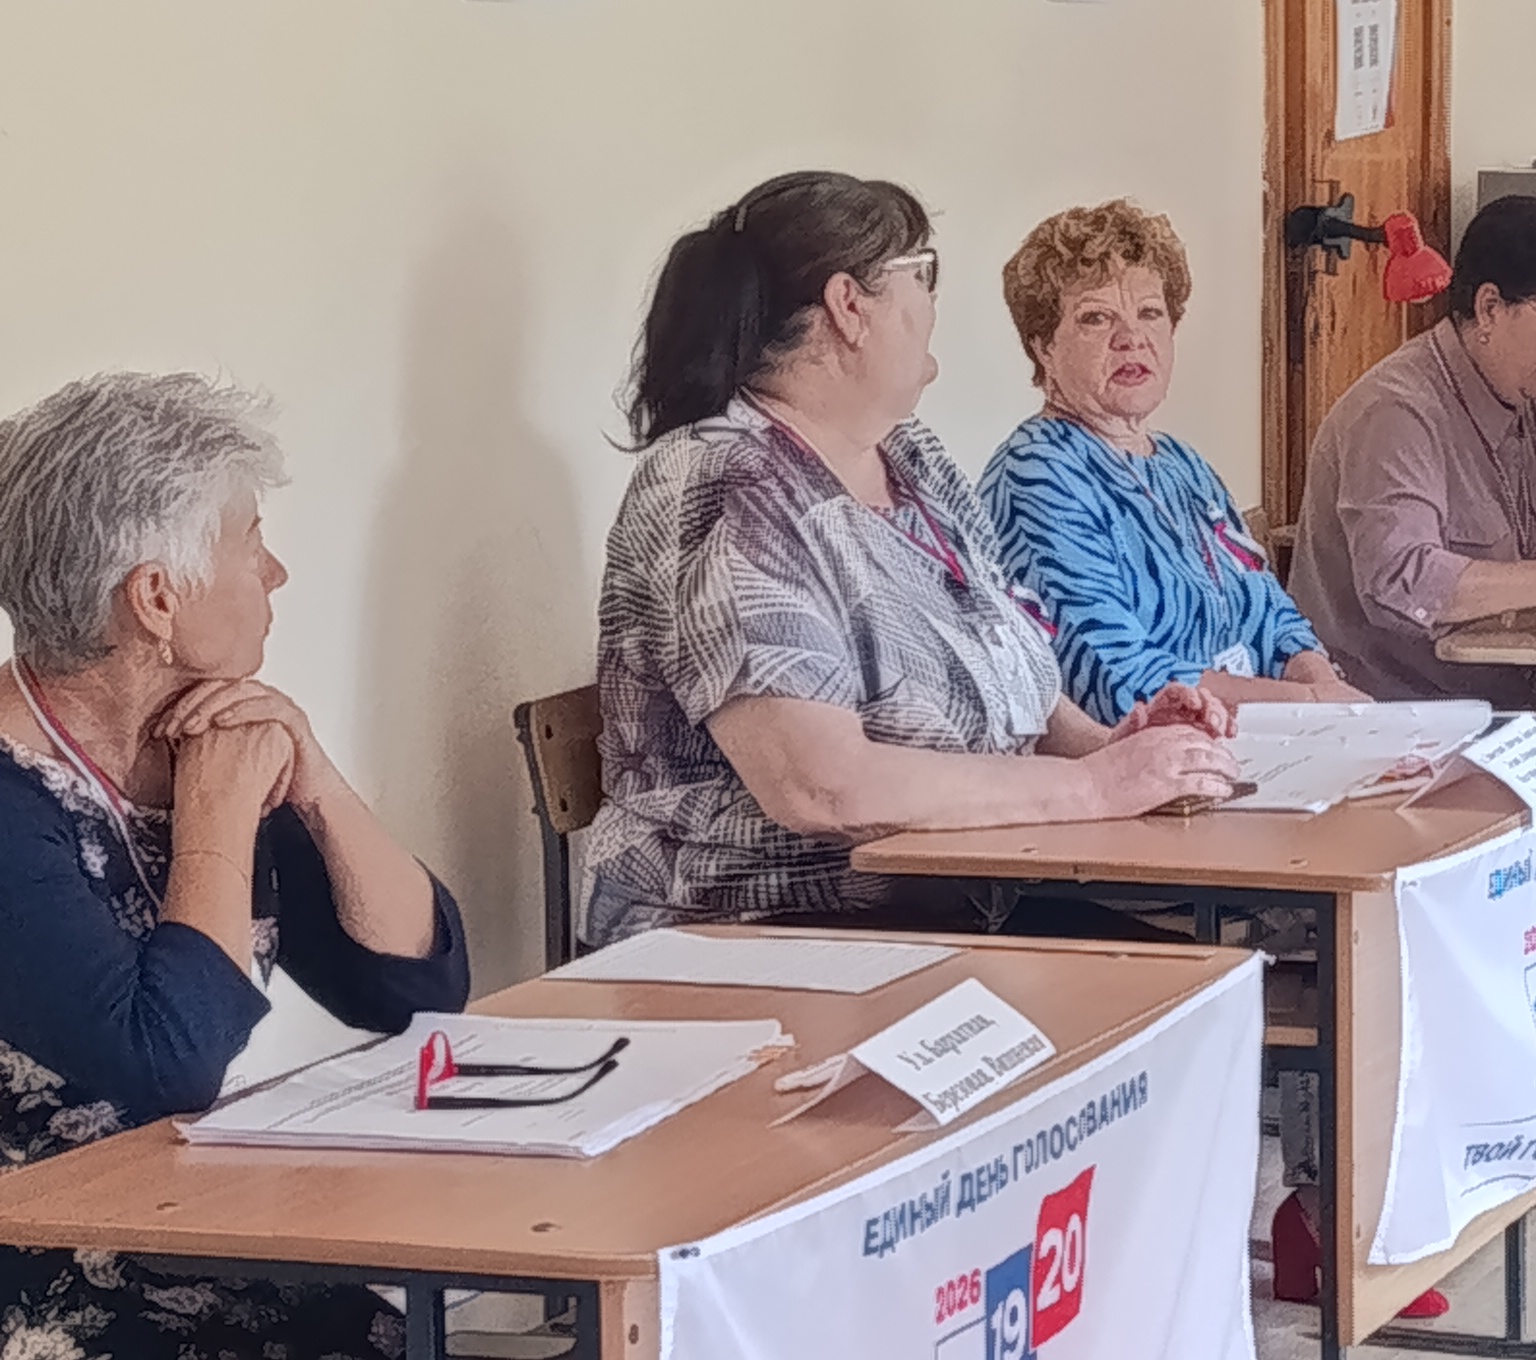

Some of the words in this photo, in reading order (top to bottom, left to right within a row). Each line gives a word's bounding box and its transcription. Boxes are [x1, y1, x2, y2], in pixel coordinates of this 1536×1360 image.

[863, 1169, 951, 1258] ЕДИНЫЙ
[955, 1154, 1009, 1219] ДЕНЬ
[1012, 1070, 1148, 1182] ГОЛОСОВАНИЯ
[934, 1268, 983, 1325] 2026
[1035, 1212, 1083, 1313] 20
